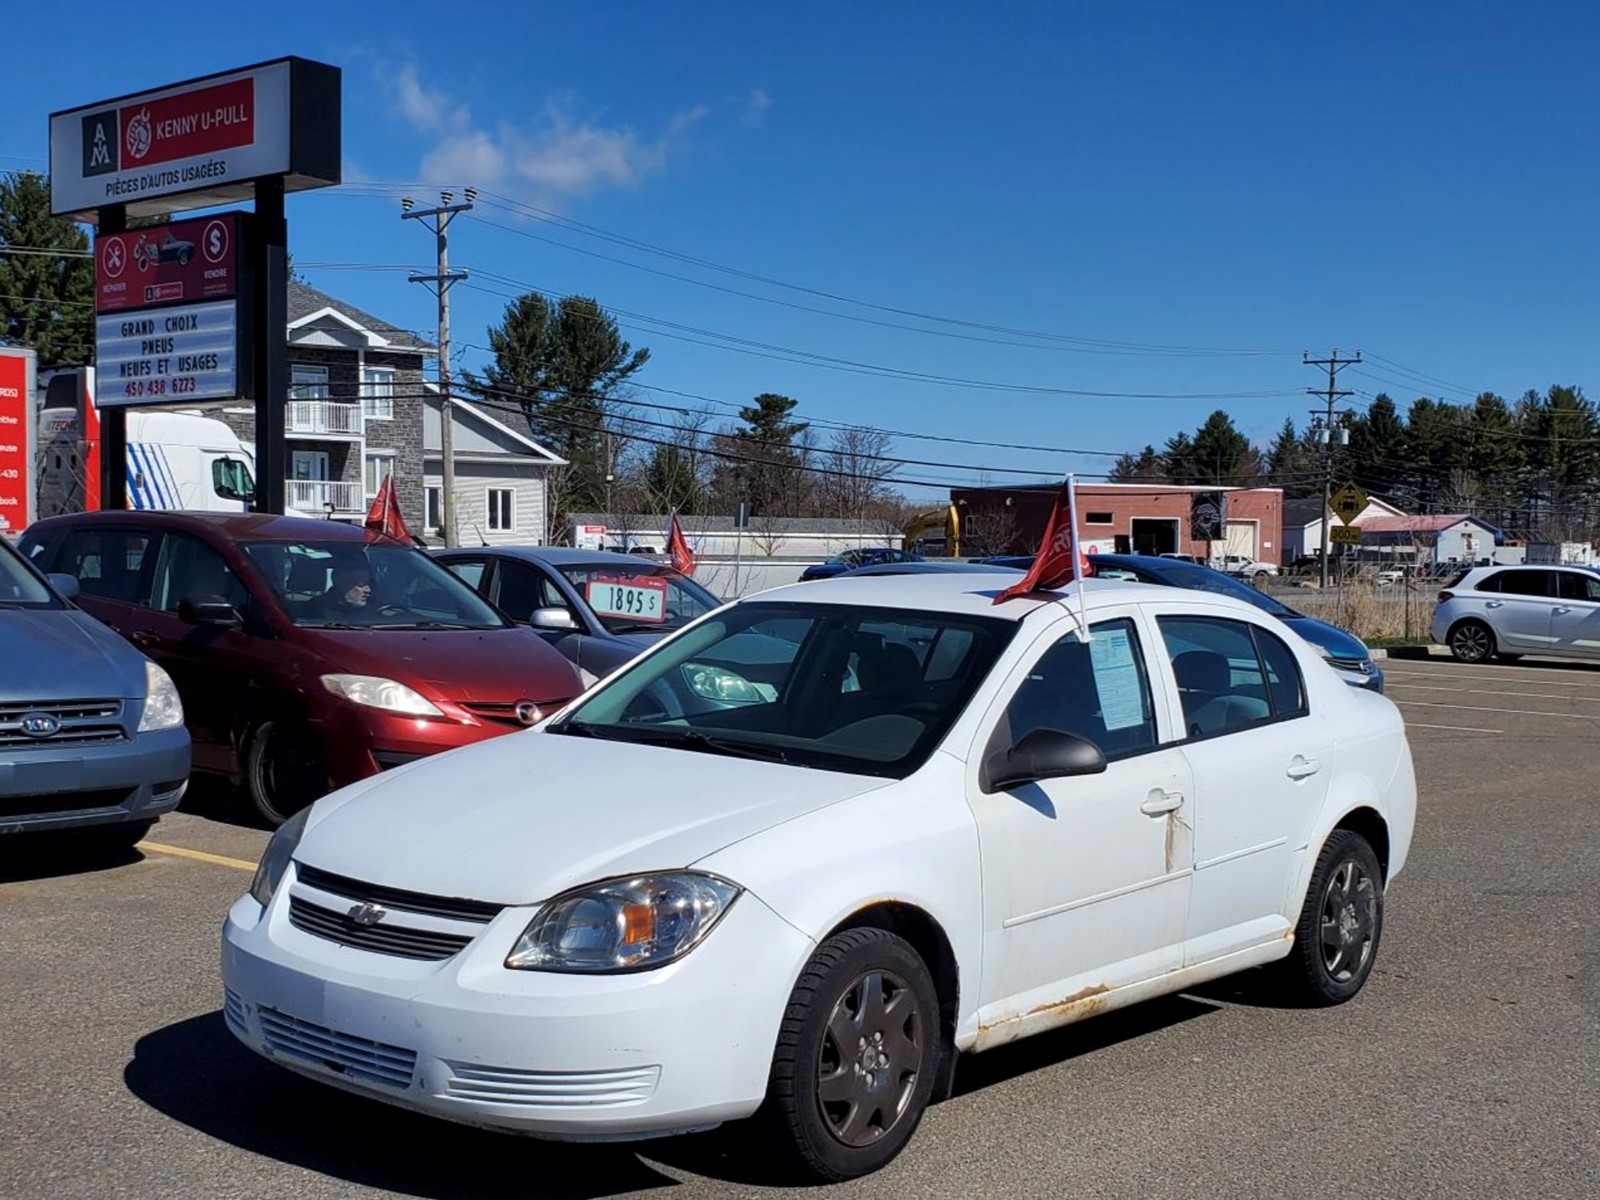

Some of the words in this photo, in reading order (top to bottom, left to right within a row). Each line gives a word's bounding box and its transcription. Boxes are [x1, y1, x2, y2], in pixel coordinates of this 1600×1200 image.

[156, 113, 198, 140] KENNY
[201, 103, 248, 131] U-PULL
[106, 176, 139, 197] PIÈCES
[140, 169, 180, 192] D'AUTOS
[181, 159, 226, 183] USAGÉES
[121, 319, 155, 338] GRAND
[165, 314, 198, 331] CHOIX
[141, 337, 174, 356] PNEUS
[120, 361, 151, 378] NEUFS
[157, 358, 170, 374] ET
[178, 353, 218, 371] USAGES
[125, 381, 144, 397] 450
[147, 379, 166, 395] 438
[172, 377, 196, 393] 6273
[0, 468, 18, 479] -430
[609, 586, 644, 614] 1895
[25, 719, 56, 732] KIA
